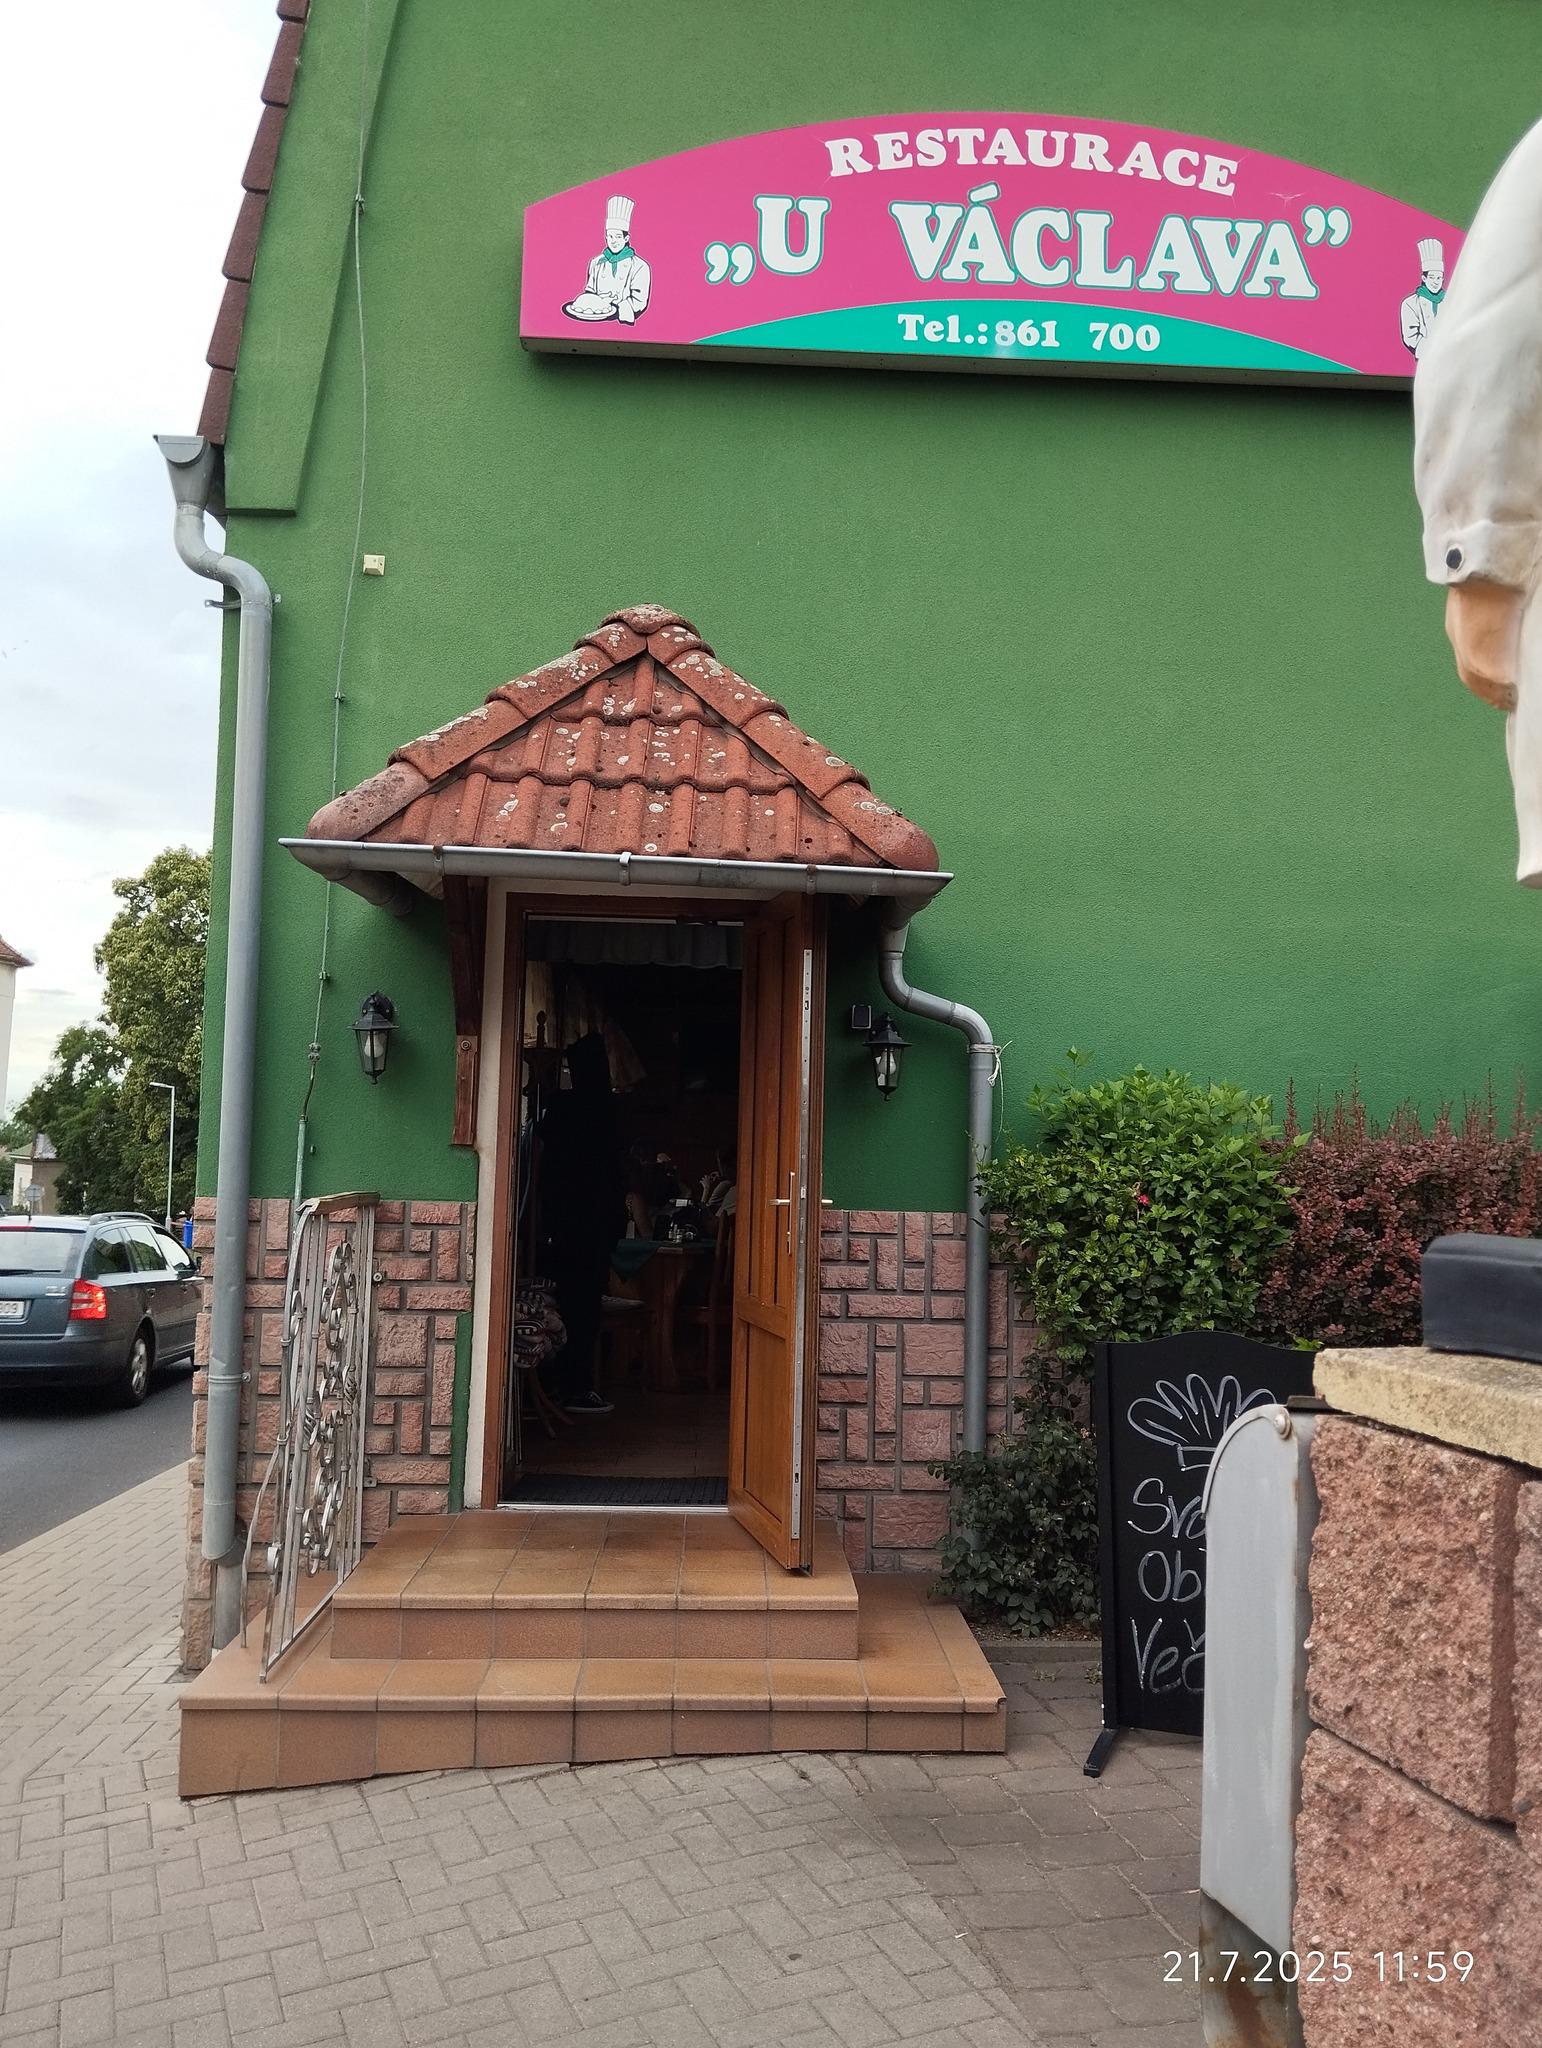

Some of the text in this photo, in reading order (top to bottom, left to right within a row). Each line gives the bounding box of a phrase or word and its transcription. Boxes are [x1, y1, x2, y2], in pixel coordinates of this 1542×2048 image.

[825, 127, 1238, 197] RESTAURACE
[1089, 321, 1161, 352] 700
[1127, 1477, 1206, 1540] Sva
[1138, 1549, 1206, 1603] Ob
